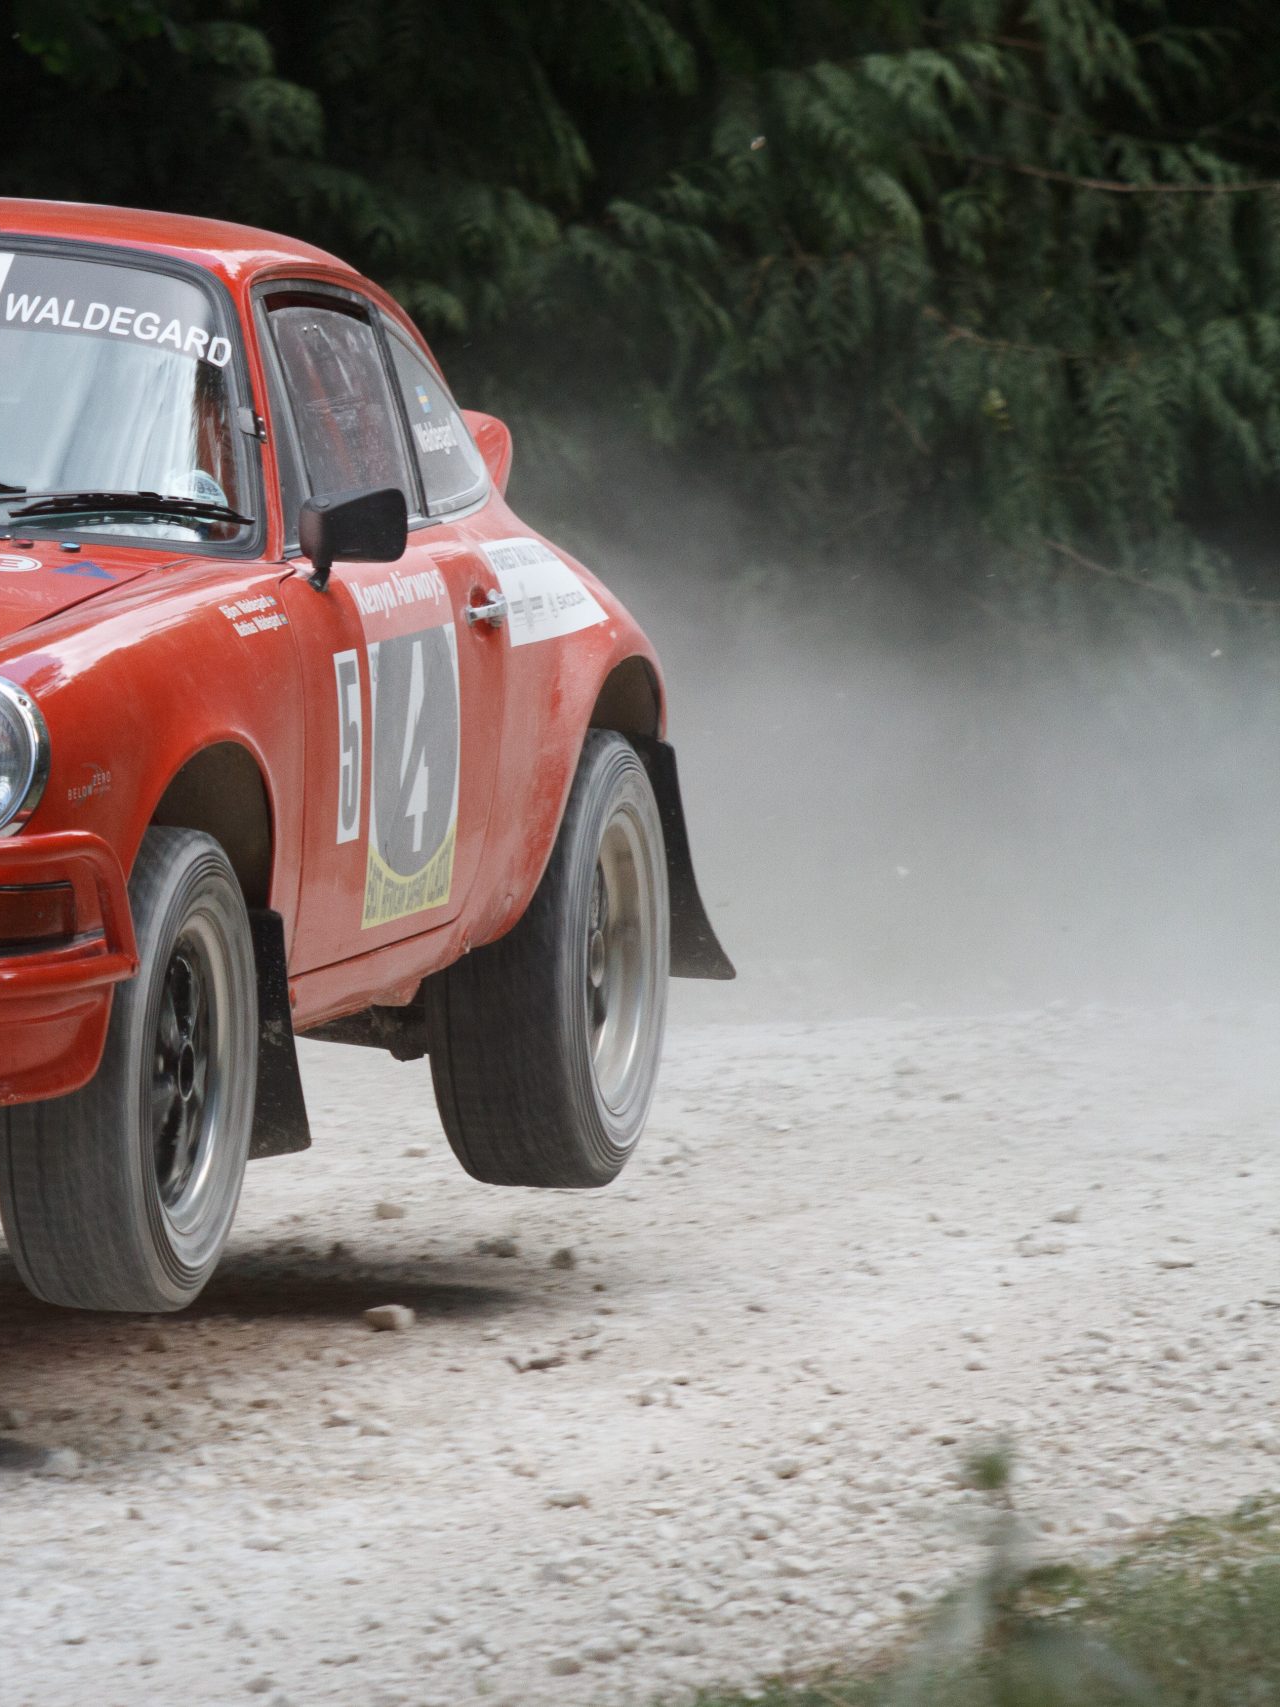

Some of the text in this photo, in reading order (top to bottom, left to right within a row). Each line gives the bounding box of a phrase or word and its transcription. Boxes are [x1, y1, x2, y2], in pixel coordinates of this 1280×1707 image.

[4, 293, 235, 369] WALDEGARD
[349, 569, 446, 618] Kenya Airways
[338, 661, 359, 831] 5
[400, 640, 429, 853] 4
